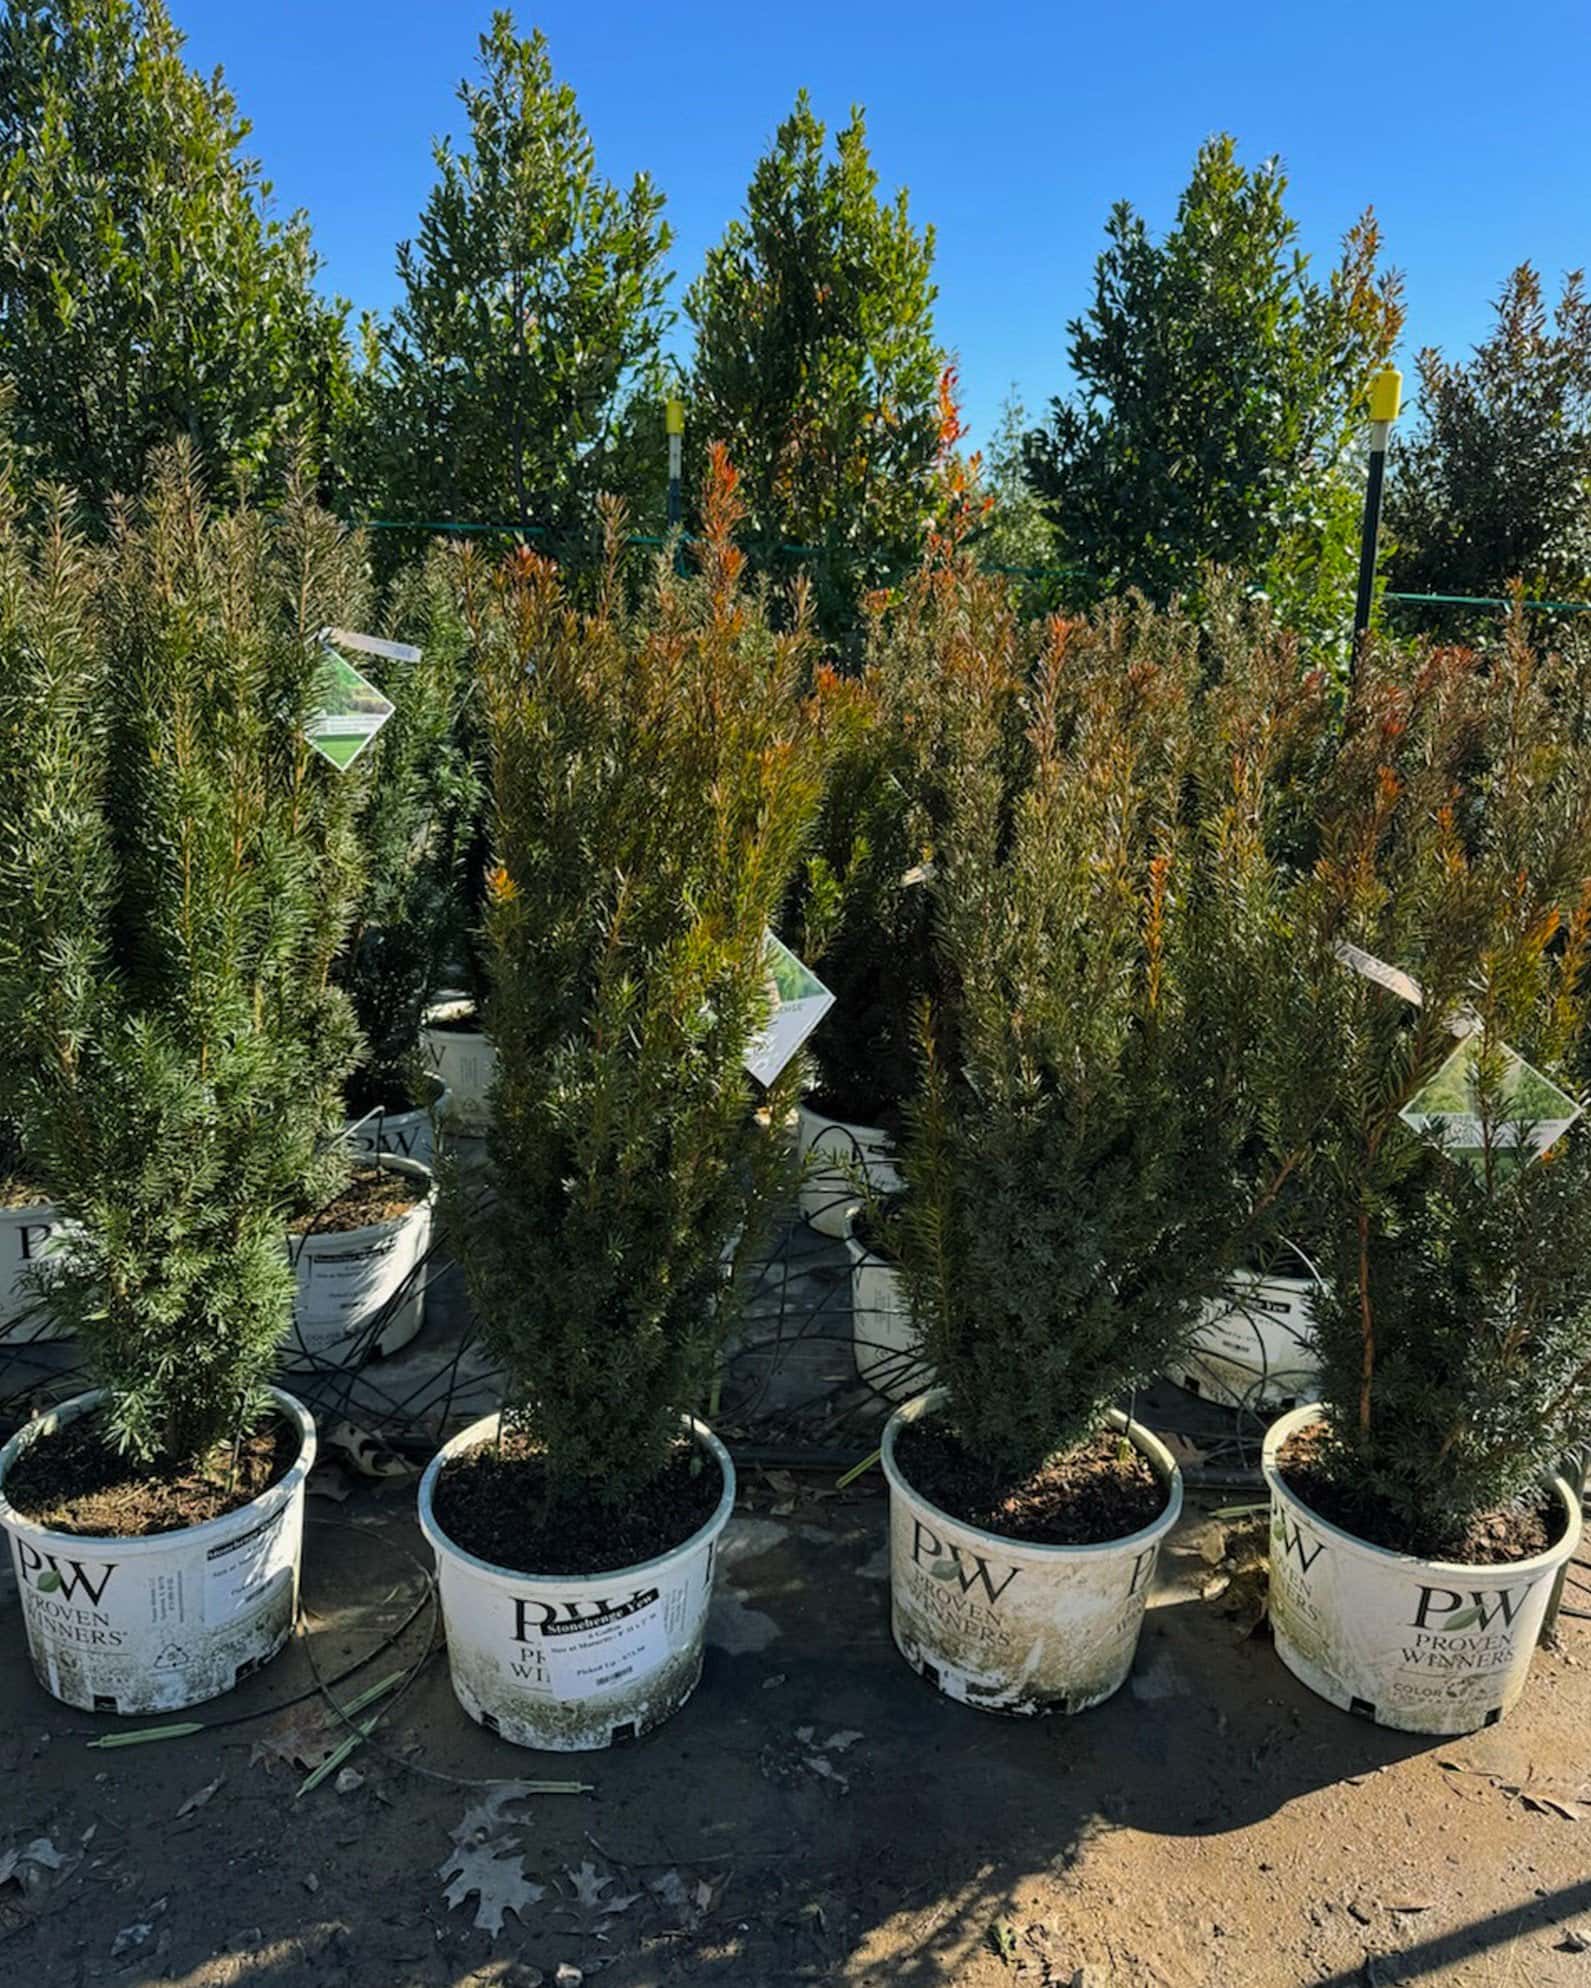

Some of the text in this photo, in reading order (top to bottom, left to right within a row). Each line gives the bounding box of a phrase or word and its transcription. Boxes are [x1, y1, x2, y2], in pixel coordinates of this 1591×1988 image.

[16, 1536, 119, 1606] PW
[911, 1516, 1024, 1604] PW
[546, 1609, 624, 1633] Stonehenge
[1405, 1581, 1536, 1632] PW
[1416, 1632, 1513, 1653] PROVEN
